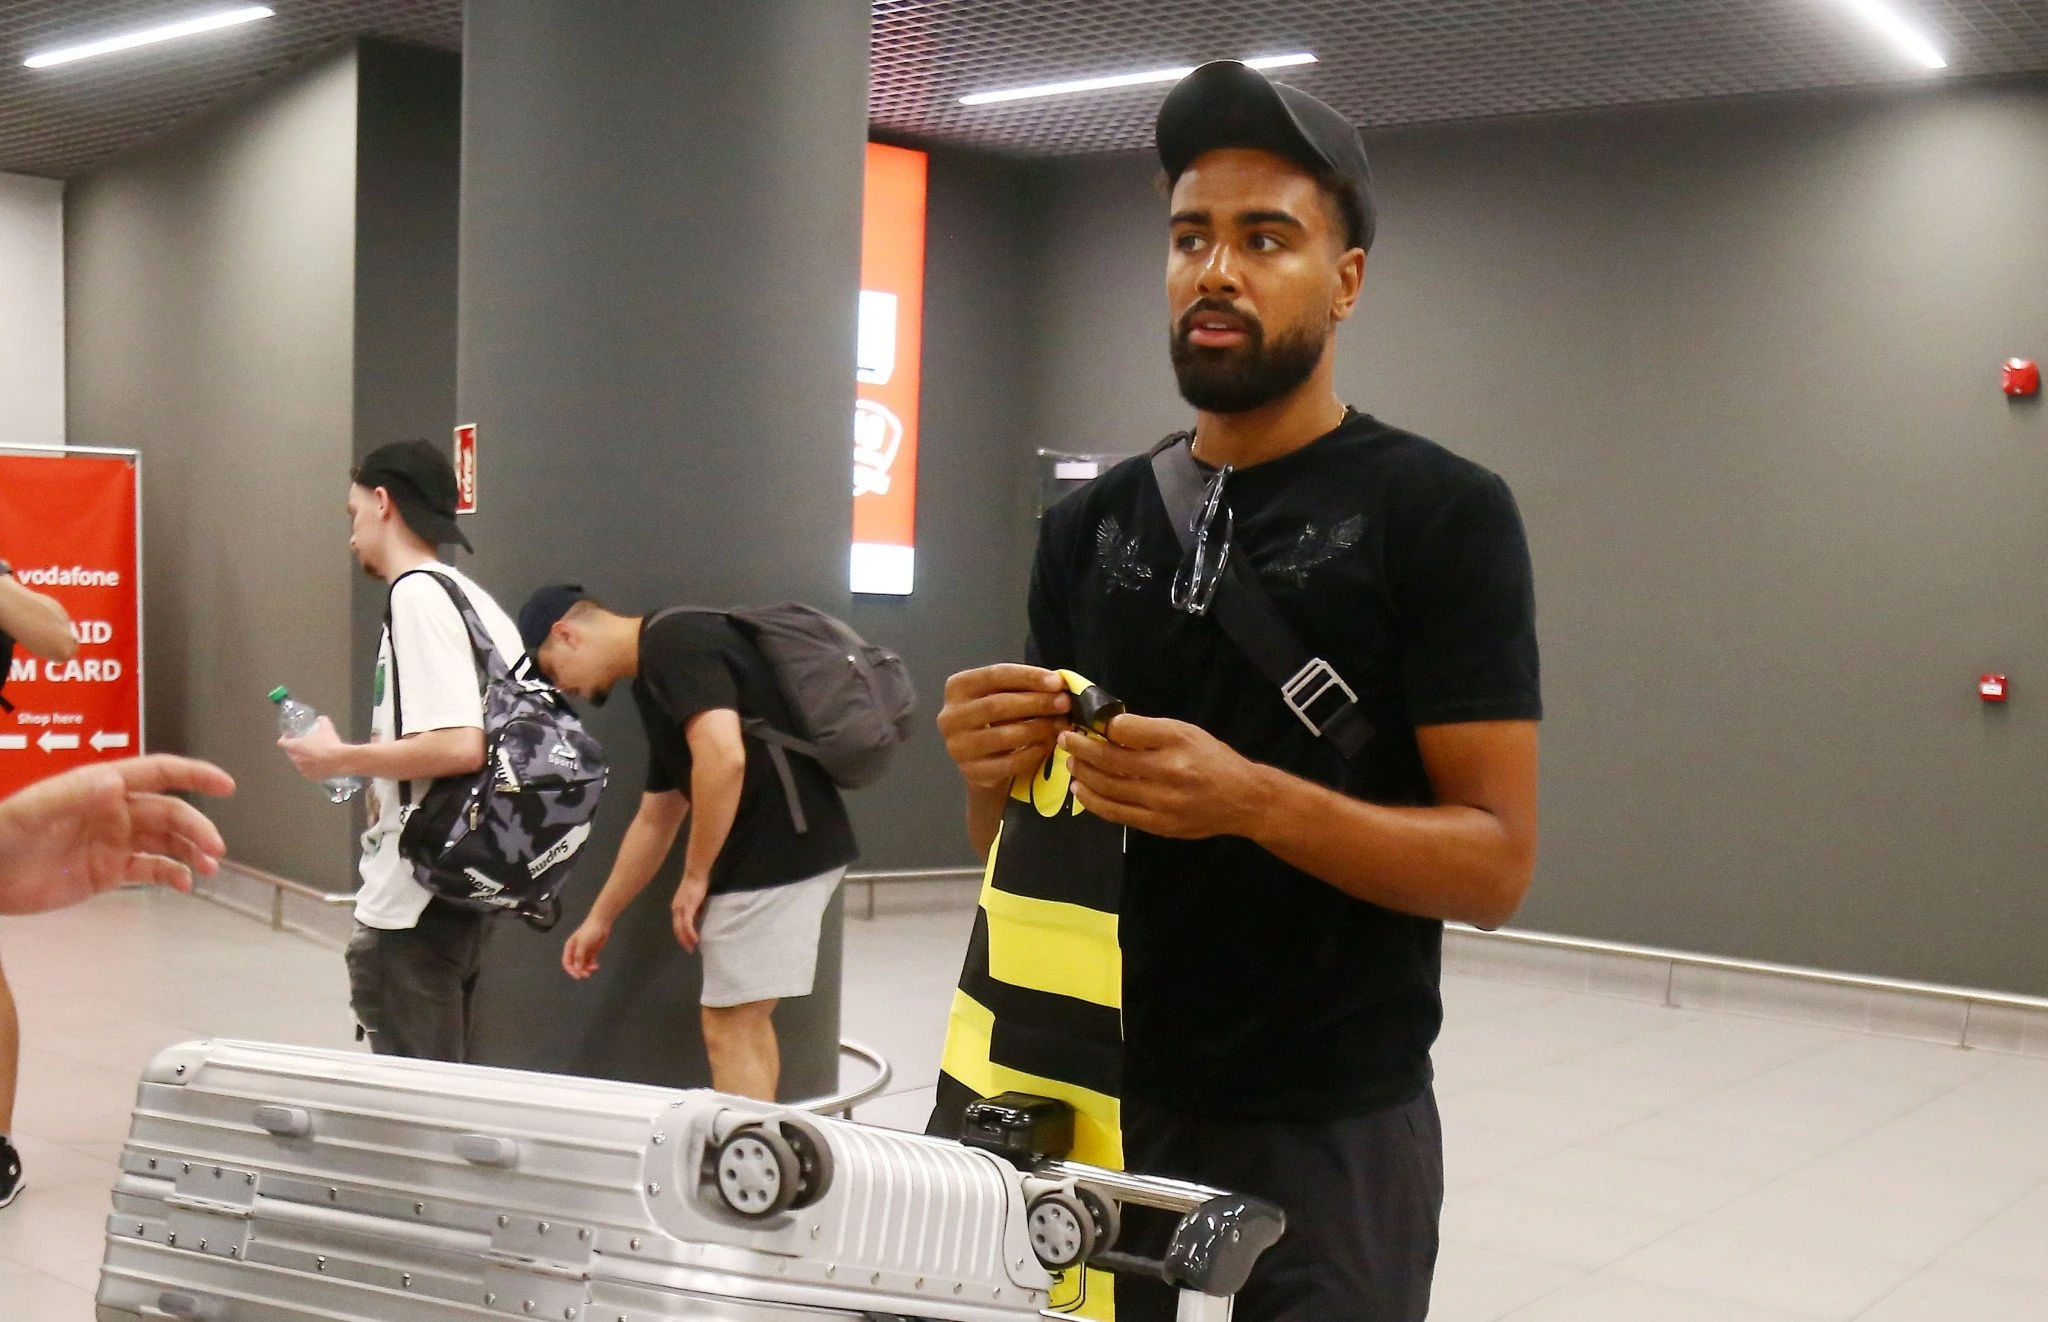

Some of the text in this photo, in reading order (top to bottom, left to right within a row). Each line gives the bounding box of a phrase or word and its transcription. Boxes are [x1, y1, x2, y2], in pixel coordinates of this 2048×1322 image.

[17, 566, 120, 586] vodafone
[45, 658, 122, 682] CARD
[17, 713, 83, 726] Shop here
